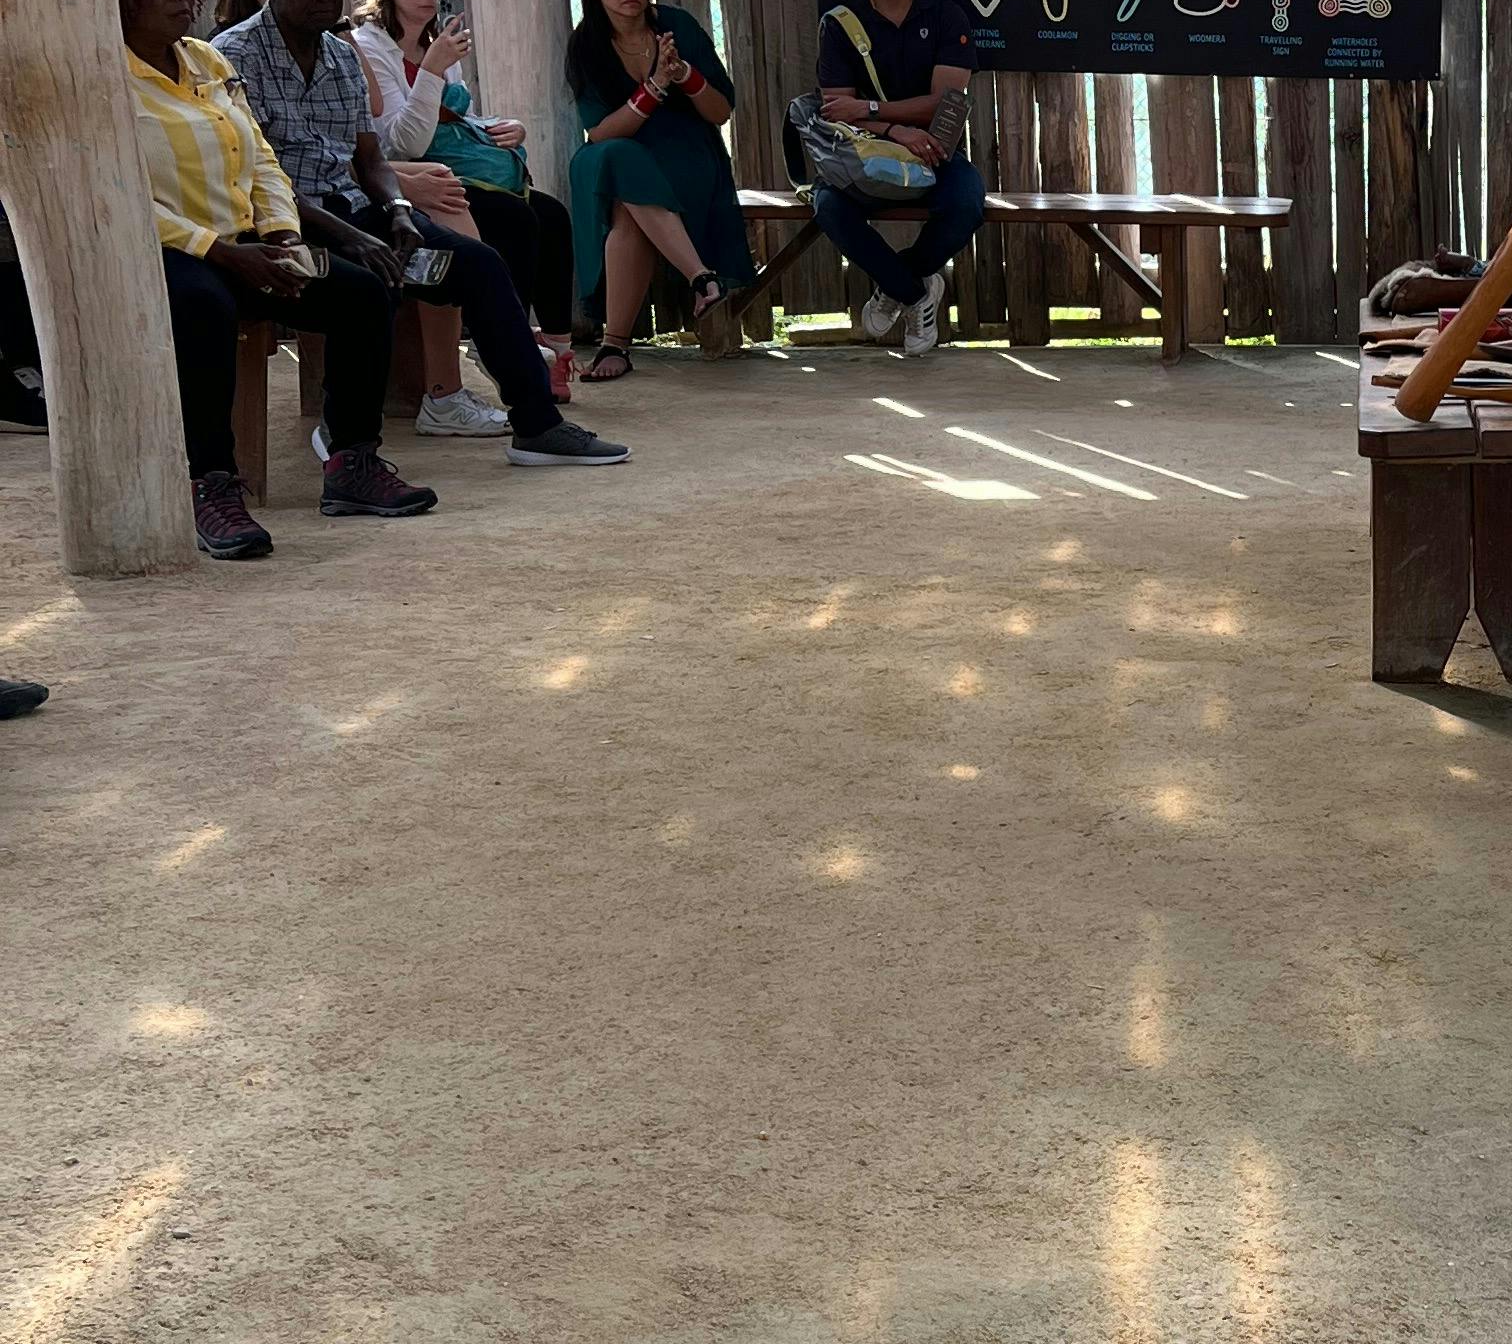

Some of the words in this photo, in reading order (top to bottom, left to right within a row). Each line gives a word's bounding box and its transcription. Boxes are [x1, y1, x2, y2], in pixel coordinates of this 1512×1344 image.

[1037, 30, 1078, 40] COOLAMON
[1111, 32, 1142, 42] DIGGING
[1143, 33, 1155, 42] OR
[1188, 34, 1226, 43] WOOMERA
[975, 40, 1006, 49] MERANG
[1260, 36, 1303, 46] TRAVELLING
[1332, 37, 1378, 47] WATERHOLES
[1111, 42, 1154, 52] CLAPSTICKS
[1272, 46, 1290, 56] SIGN
[1327, 47, 1370, 57] CONNECTED
[1372, 48, 1382, 57] BY
[1324, 58, 1358, 67] RUNNING
[1360, 59, 1385, 68] WATER
